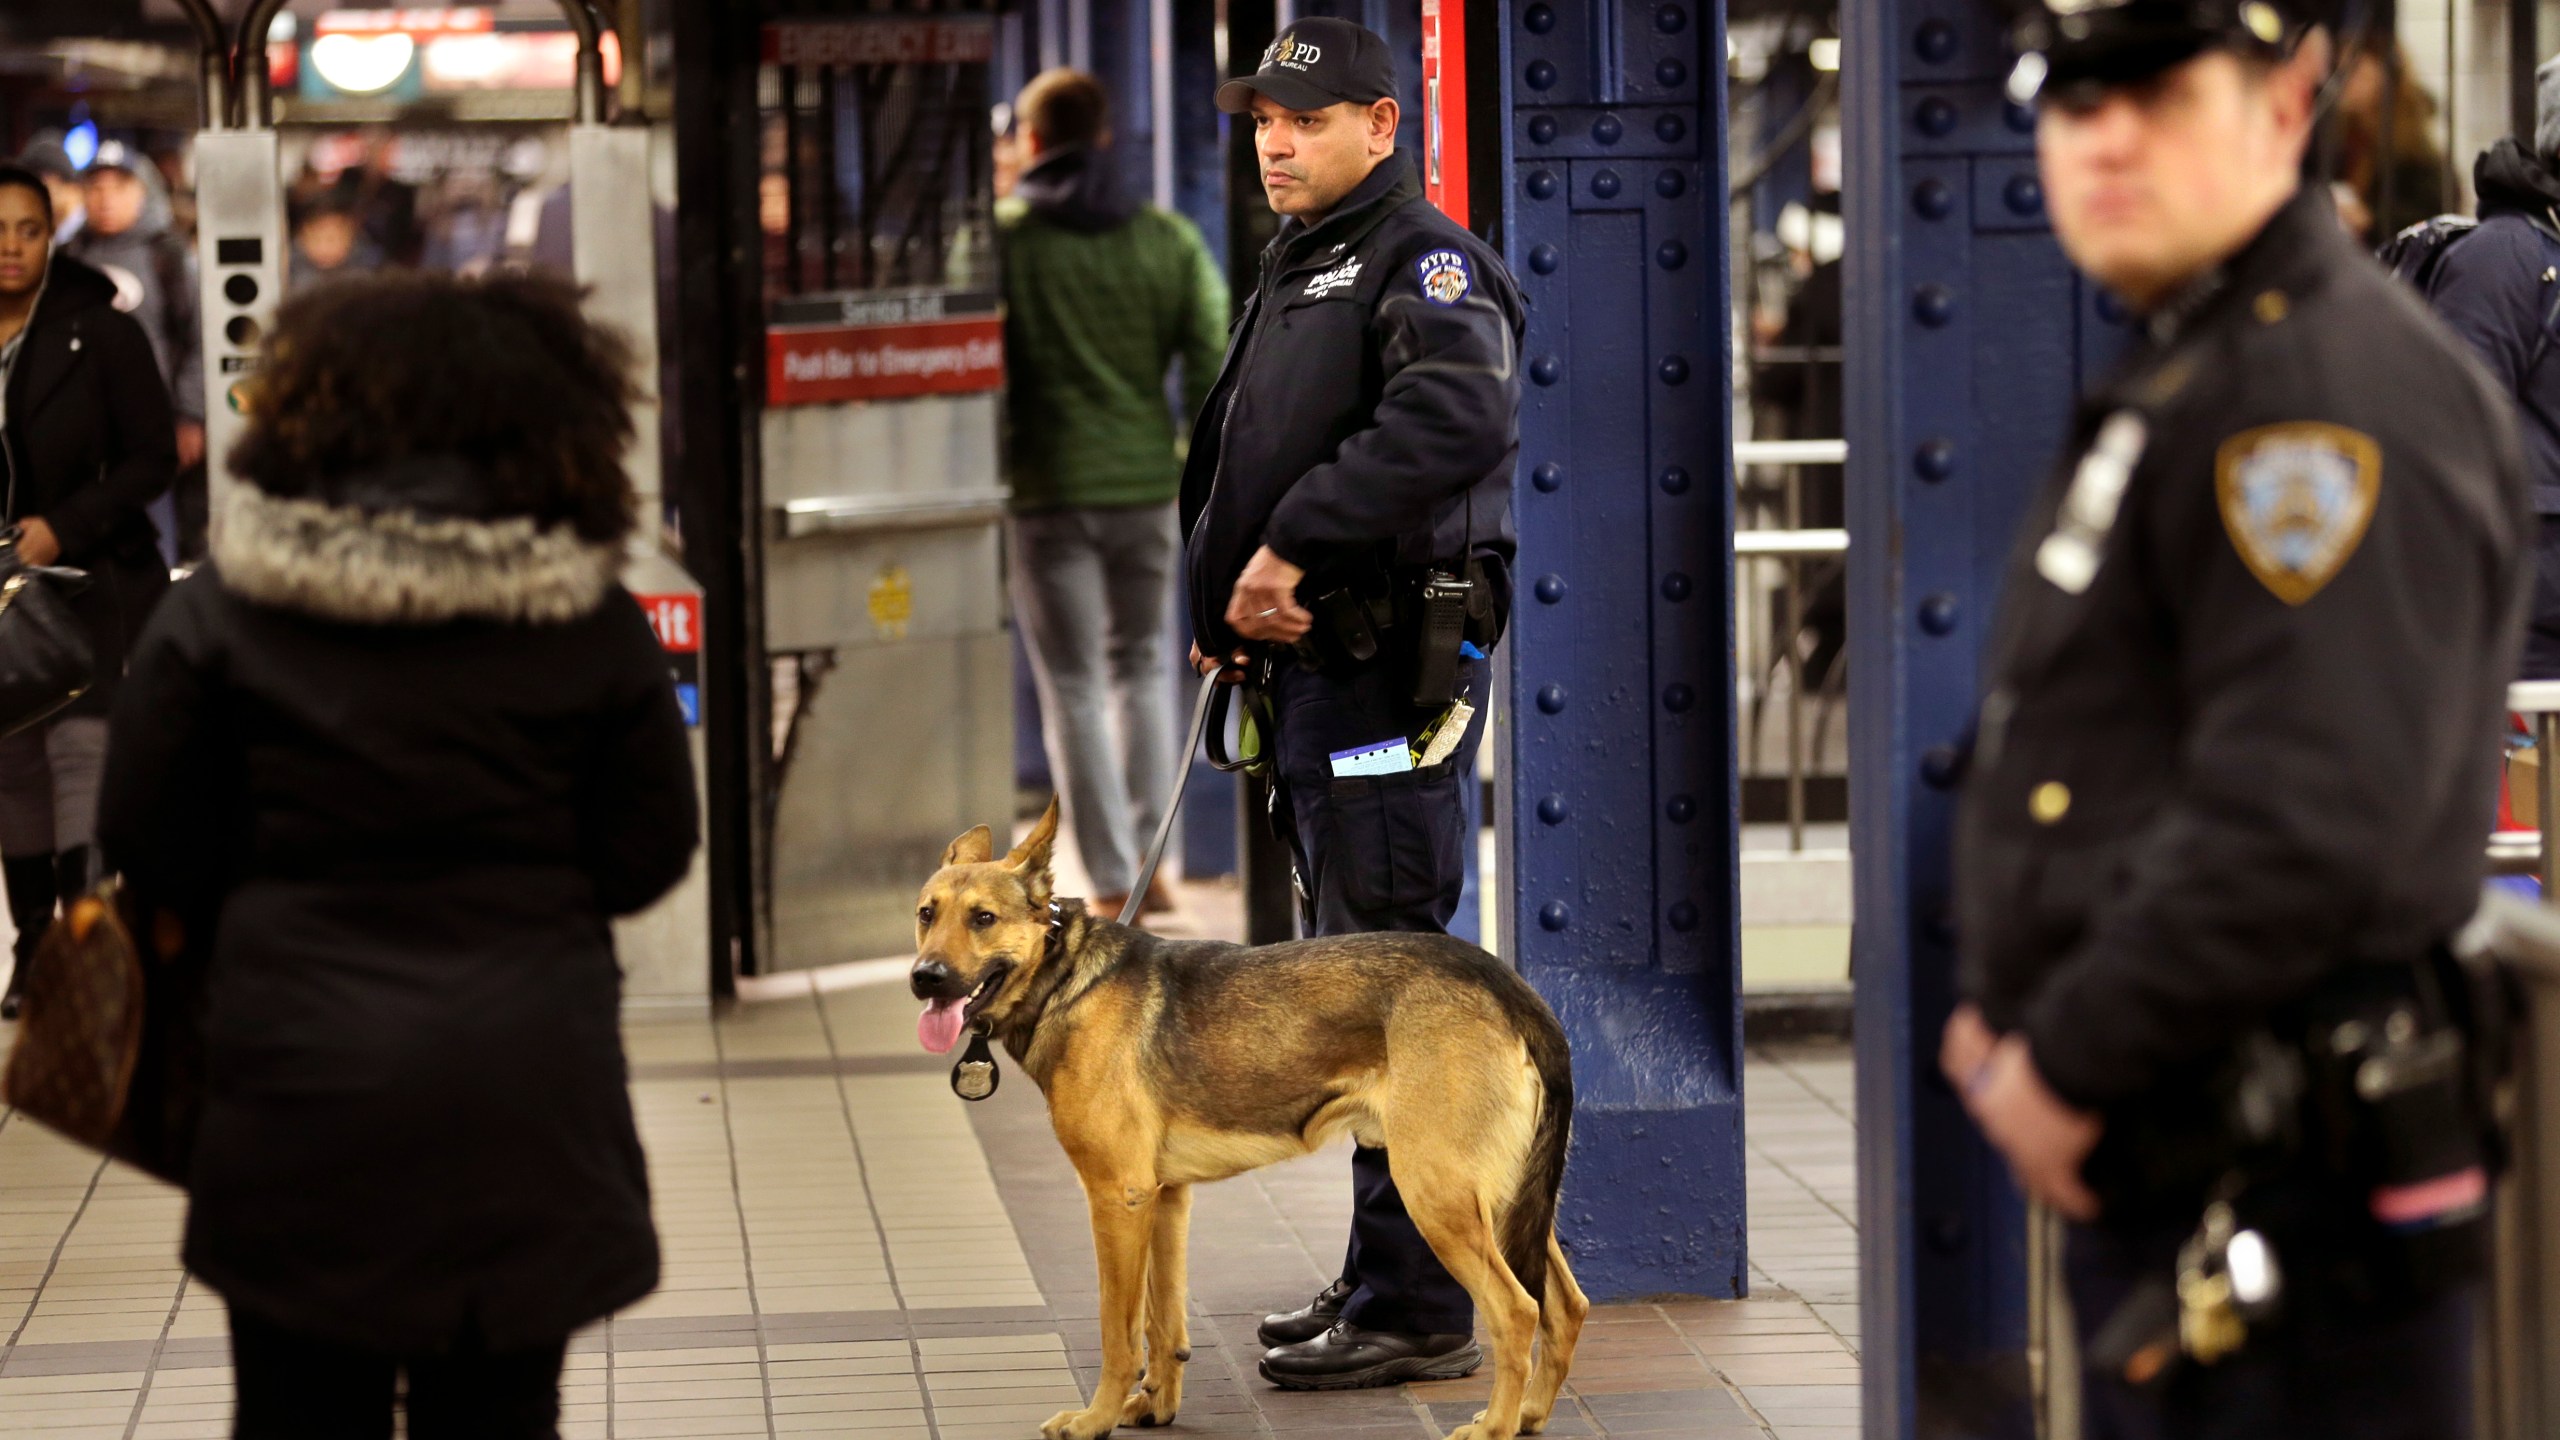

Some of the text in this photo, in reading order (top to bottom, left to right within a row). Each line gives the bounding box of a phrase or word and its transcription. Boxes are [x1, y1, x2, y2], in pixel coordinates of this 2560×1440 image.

[778, 20, 991, 63] EMERGENCY EXIT
[1292, 42, 1321, 64] PD
[1280, 61, 1308, 72] BUREAU
[1308, 263, 1363, 288] POLICE
[1420, 252, 1462, 274] NYPD
[842, 288, 945, 324] Service Exit
[784, 350, 823, 382] Push
[825, 347, 853, 380] Bar
[880, 343, 965, 379] Emergency
